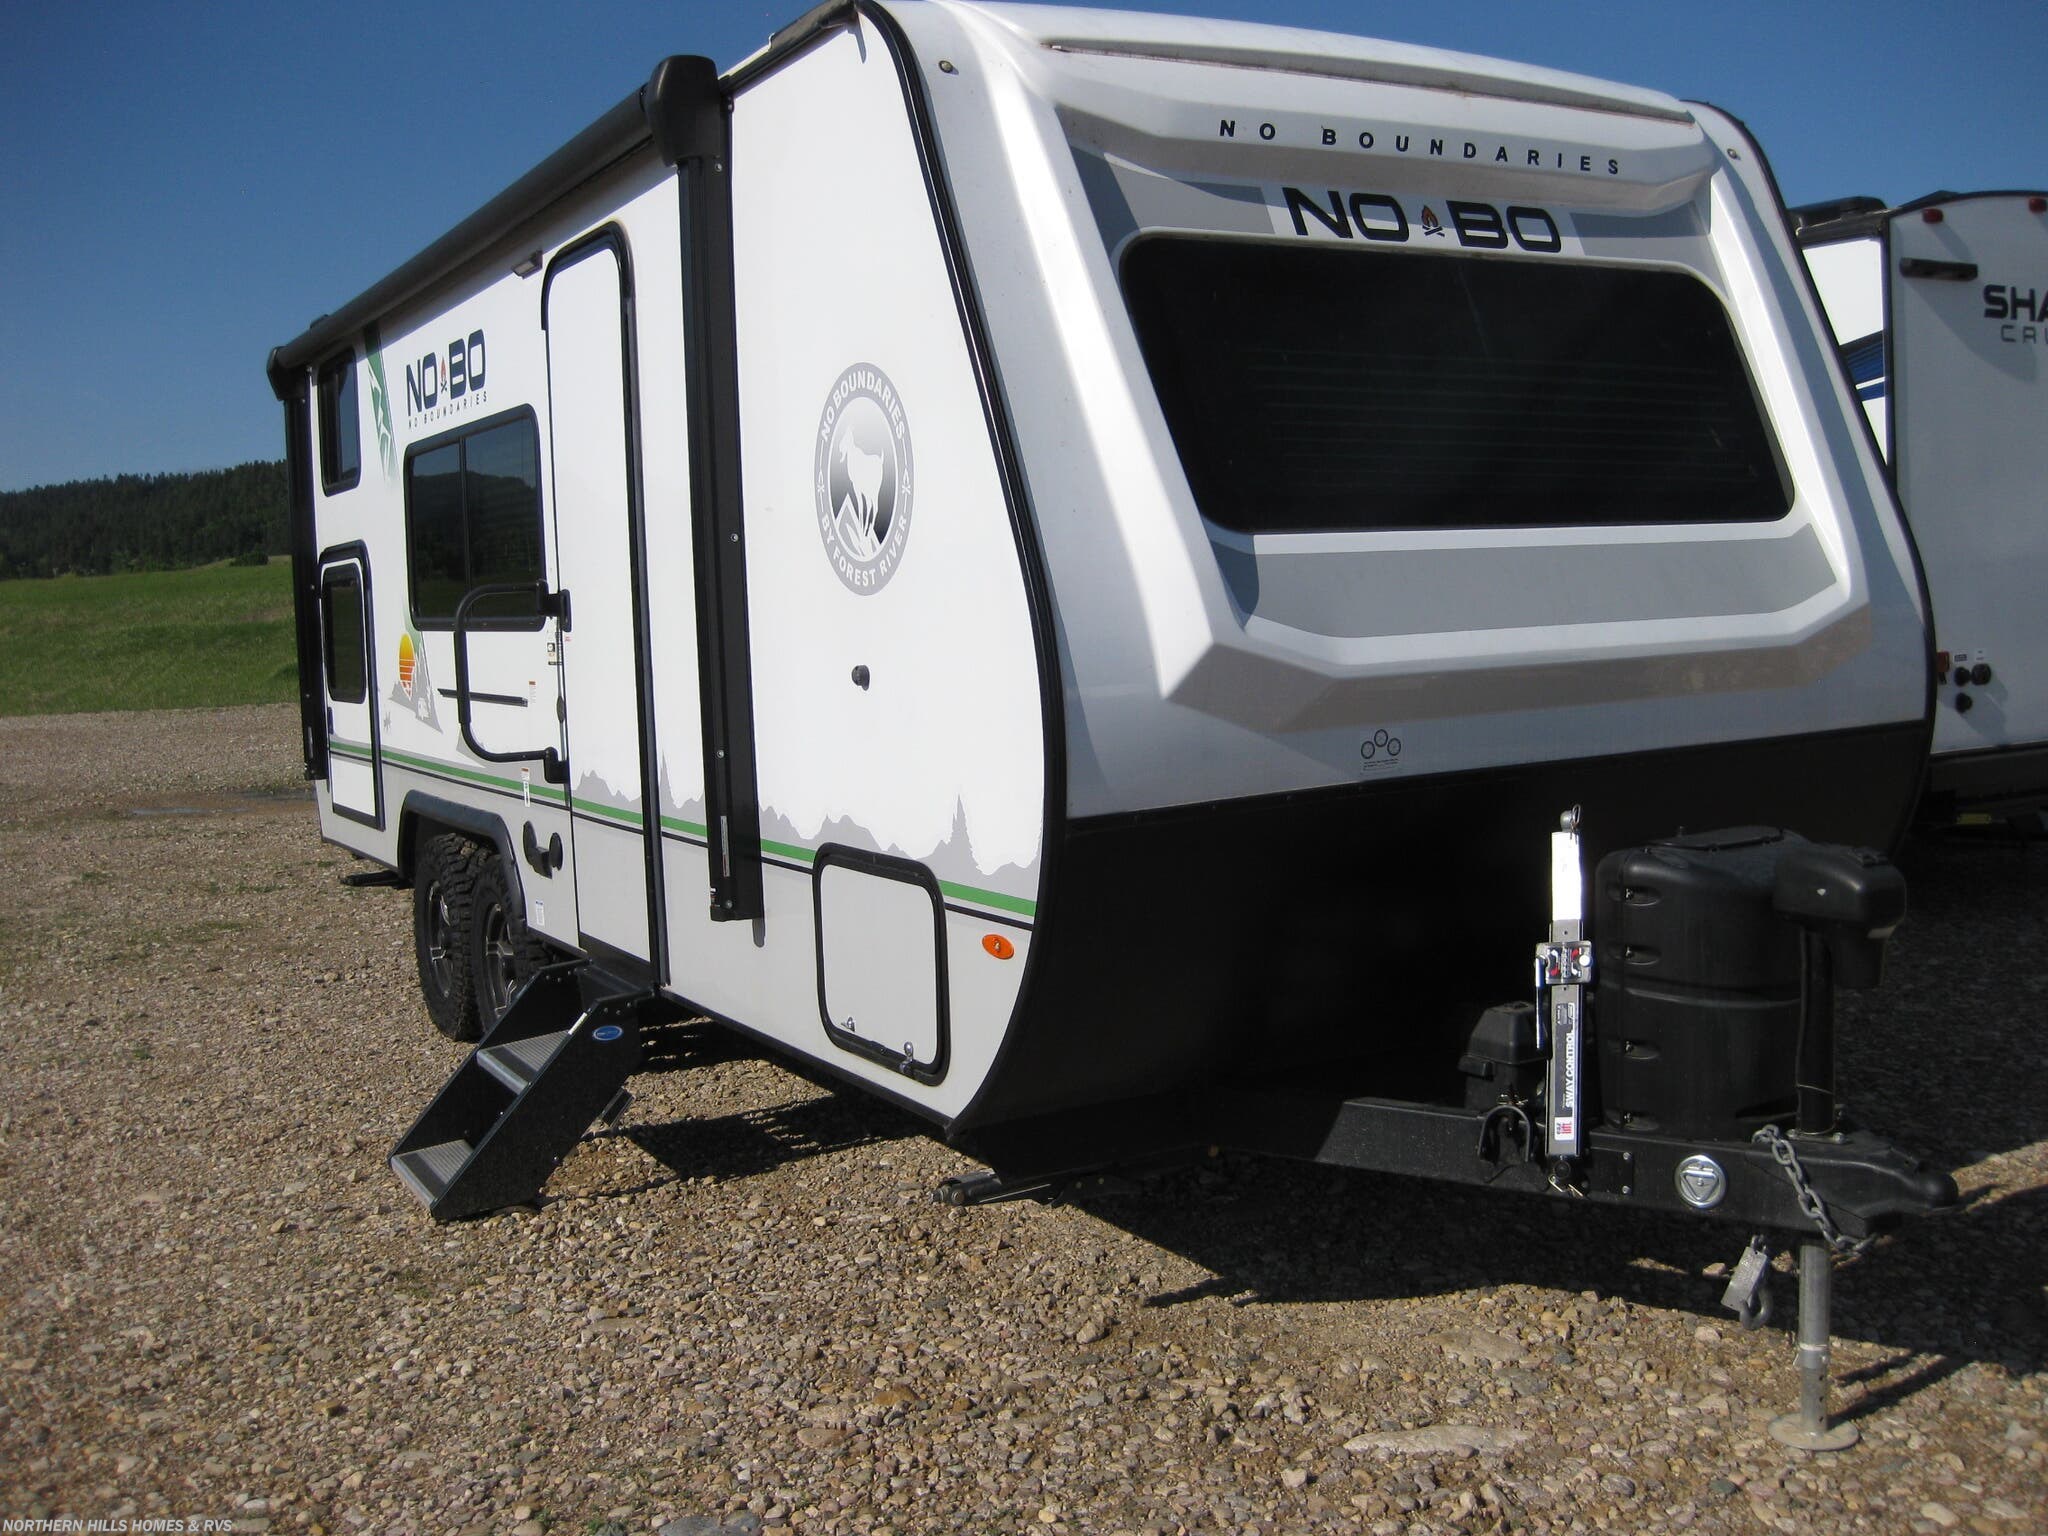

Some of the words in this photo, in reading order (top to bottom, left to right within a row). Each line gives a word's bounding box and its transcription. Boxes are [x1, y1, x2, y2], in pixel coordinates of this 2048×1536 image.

[1219, 119, 1276, 141] NO
[1322, 127, 1618, 175] BOUNDARIES
[2001, 324, 2048, 344] CR
[424, 391, 487, 425] BOUNDARIES
[821, 406, 835, 442] NO
[833, 370, 905, 440] BOUNDARIES
[822, 513, 835, 545] BY
[833, 545, 876, 587] FOREST
[880, 515, 907, 577] RIVER
[1566, 1029, 1574, 1077] CONTROL
[1566, 1079, 1574, 1108] SWAY
